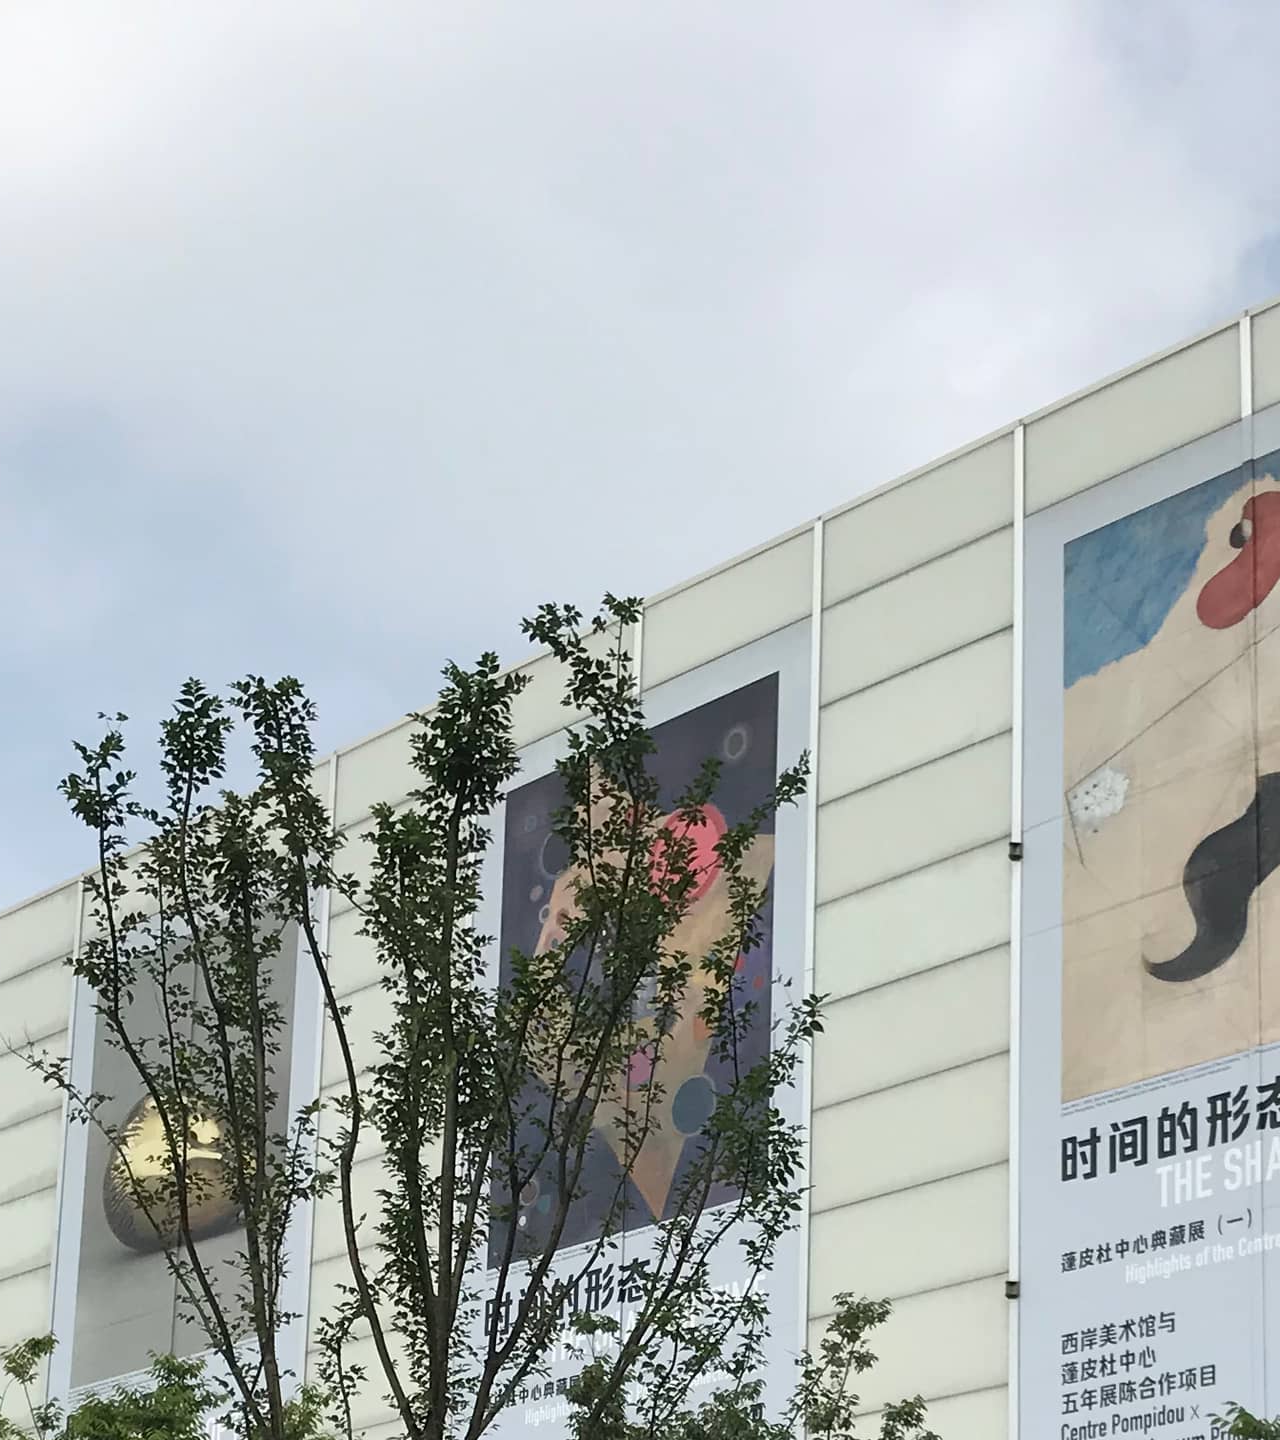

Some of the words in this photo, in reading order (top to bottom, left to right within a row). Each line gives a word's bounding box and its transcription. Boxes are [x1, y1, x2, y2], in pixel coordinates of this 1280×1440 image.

[1155, 1155, 1214, 1208] THE
[1125, 1253, 1192, 1285] Highlights
[1195, 1247, 1211, 1268] of
[1212, 1243, 1234, 1264] the
[1061, 1311, 1176, 1356] 西岸美术馆与
[1061, 1345, 1157, 1387] 蓬皮杜中心
[1061, 1364, 1217, 1416] 五年展陈合作项目
[1111, 1404, 1186, 1436] Pompidou
